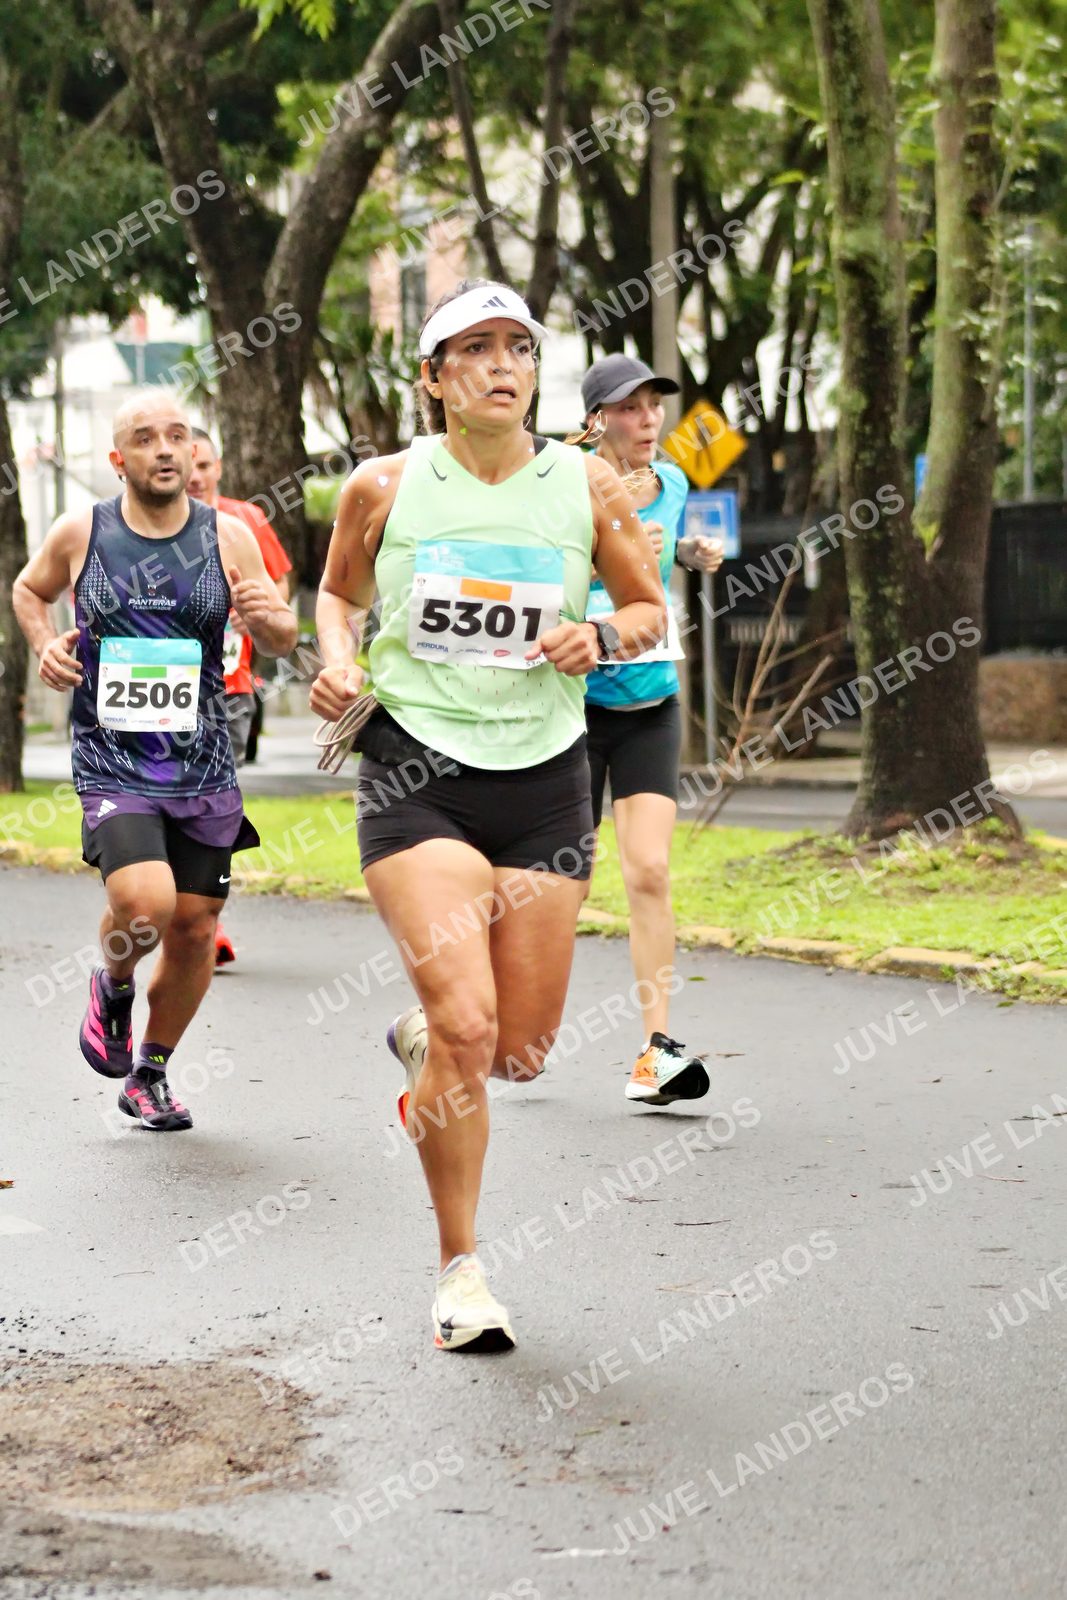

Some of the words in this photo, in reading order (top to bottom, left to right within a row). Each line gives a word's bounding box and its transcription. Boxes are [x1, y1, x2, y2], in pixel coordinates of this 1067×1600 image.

[128, 598, 177, 607] PANTERAS
[418, 598, 542, 642] 5301
[416, 641, 449, 653] PERDURA
[105, 680, 192, 709] 2506
